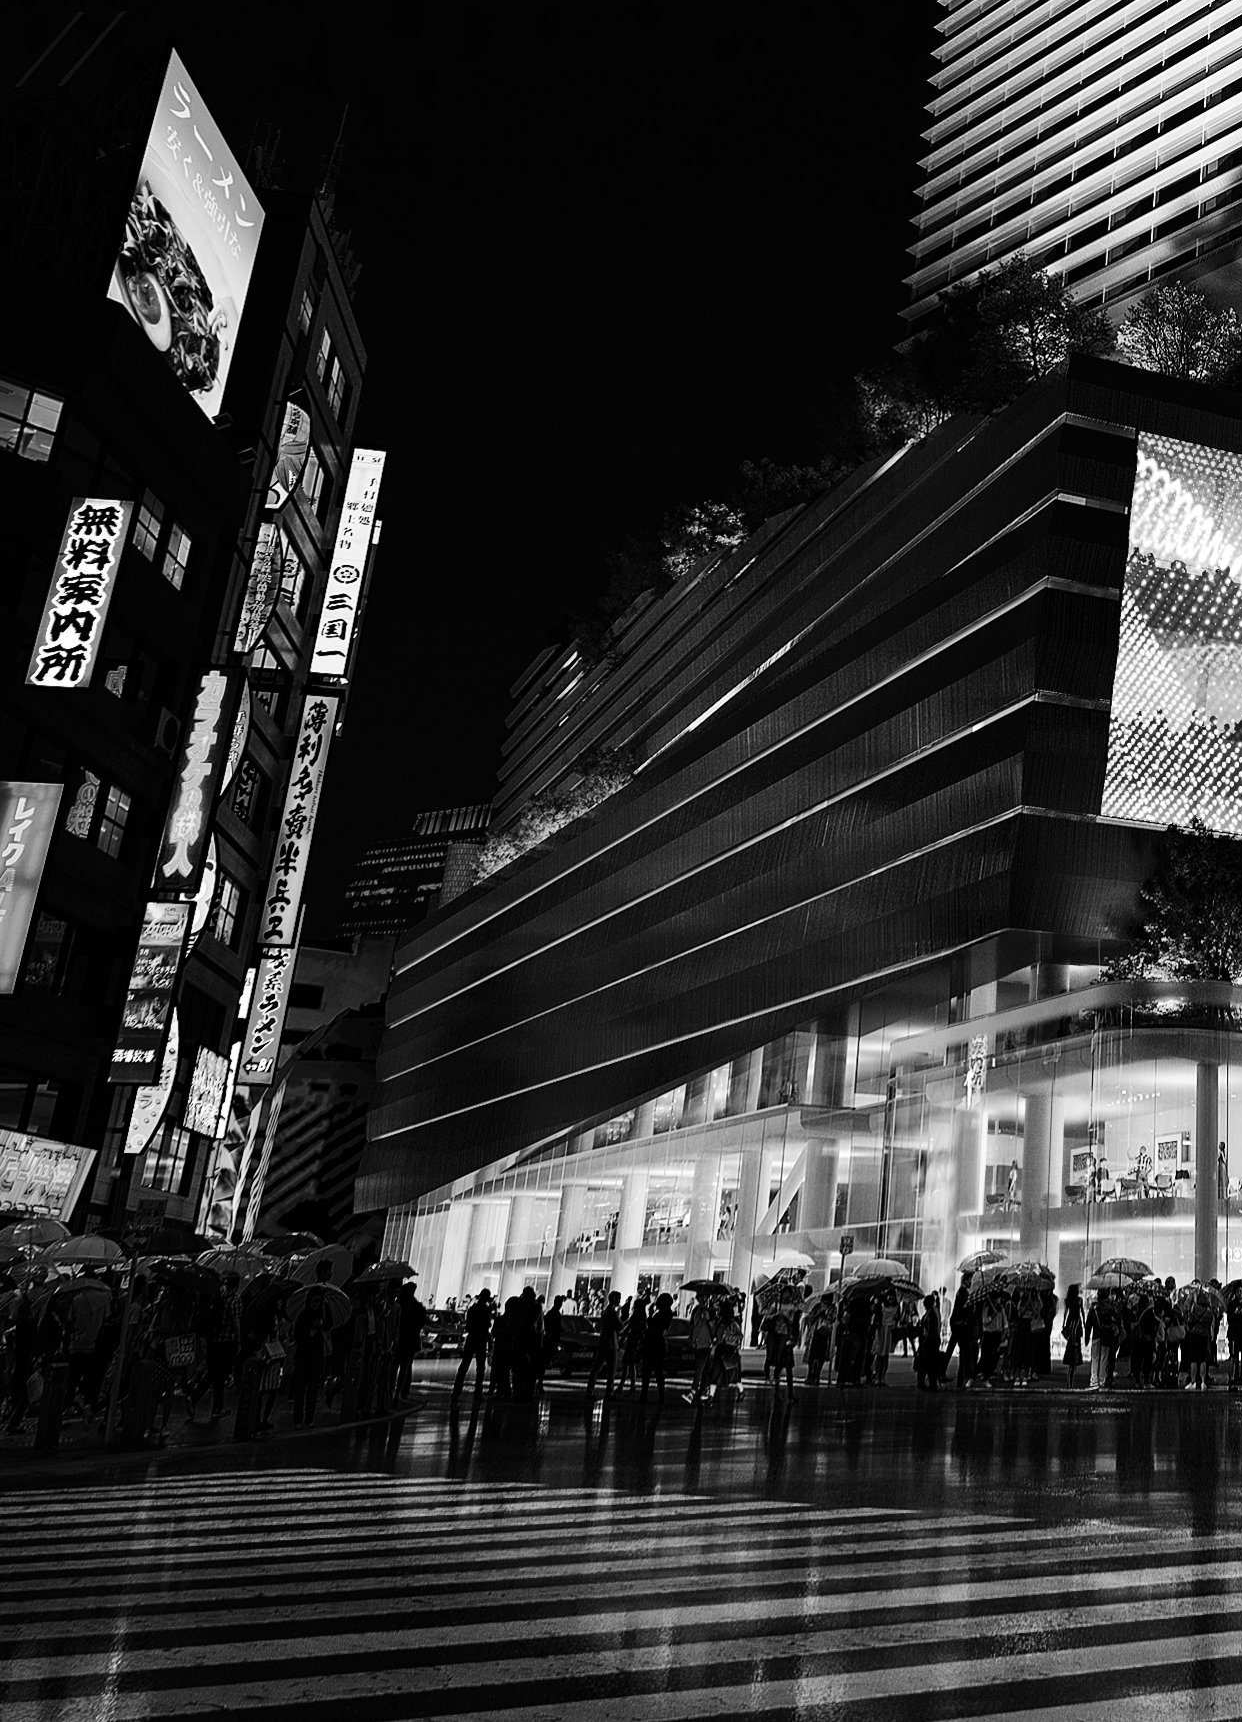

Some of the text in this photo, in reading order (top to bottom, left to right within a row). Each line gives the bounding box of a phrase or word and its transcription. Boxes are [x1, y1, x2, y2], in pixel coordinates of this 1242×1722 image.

[169, 81, 255, 227] ラーメン
[37, 505, 121, 682] 無料案内所
[316, 593, 353, 658] 三国一
[162, 670, 228, 878] カラオケの鉄人
